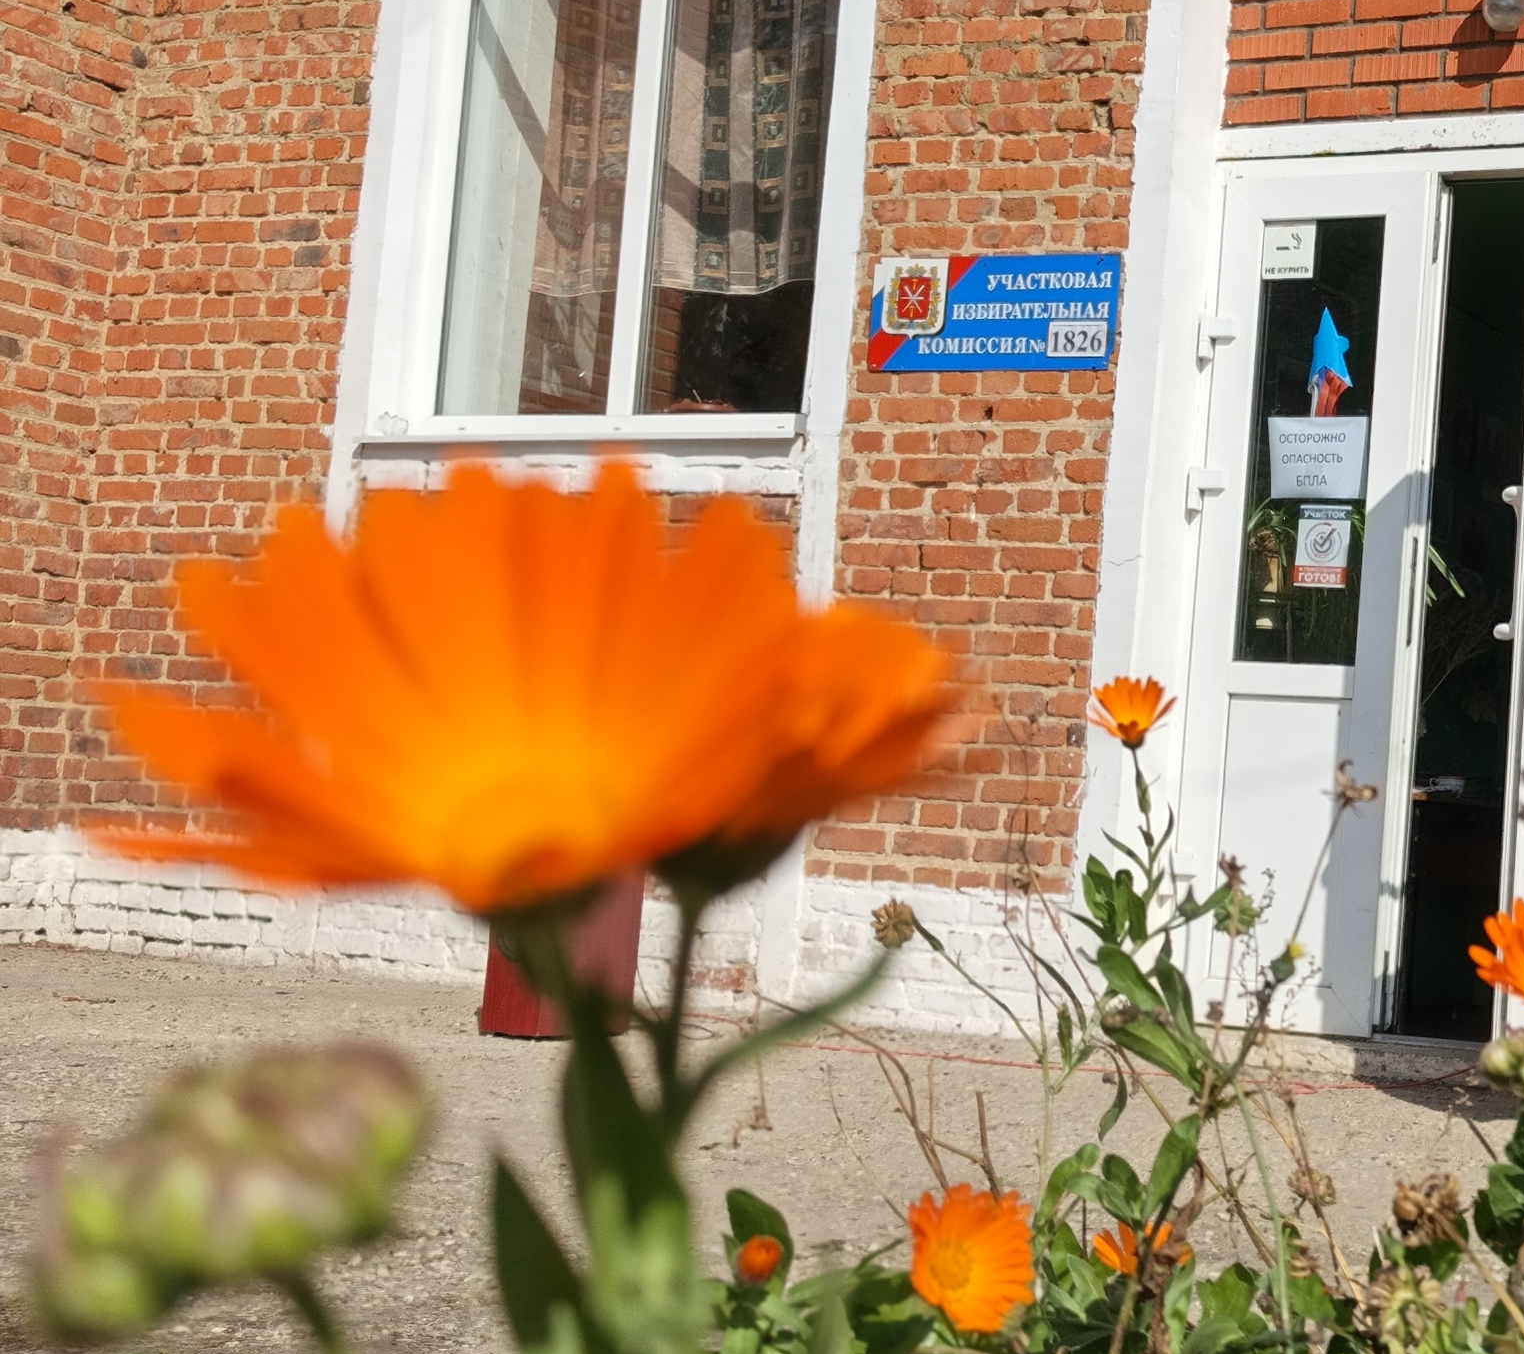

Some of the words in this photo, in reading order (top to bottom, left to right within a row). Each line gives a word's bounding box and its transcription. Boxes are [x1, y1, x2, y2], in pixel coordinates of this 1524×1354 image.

[1264, 267, 1276, 275] НЕ
[1278, 266, 1309, 274] КУРИТЬ
[987, 272, 1113, 291] УЧАСТКОВАЯ
[952, 302, 1110, 321] ИЗБИРАТЕЛЬНАЯ
[917, 337, 1028, 355] КОМИССИЯ
[1052, 329, 1102, 353] 1826
[1278, 433, 1346, 444] ОСТОРОЖНО
[1281, 453, 1343, 465] ОПАСНОСТЬ
[1296, 474, 1327, 487] БПЛА
[1298, 572, 1341, 583] ГОТОВ!
